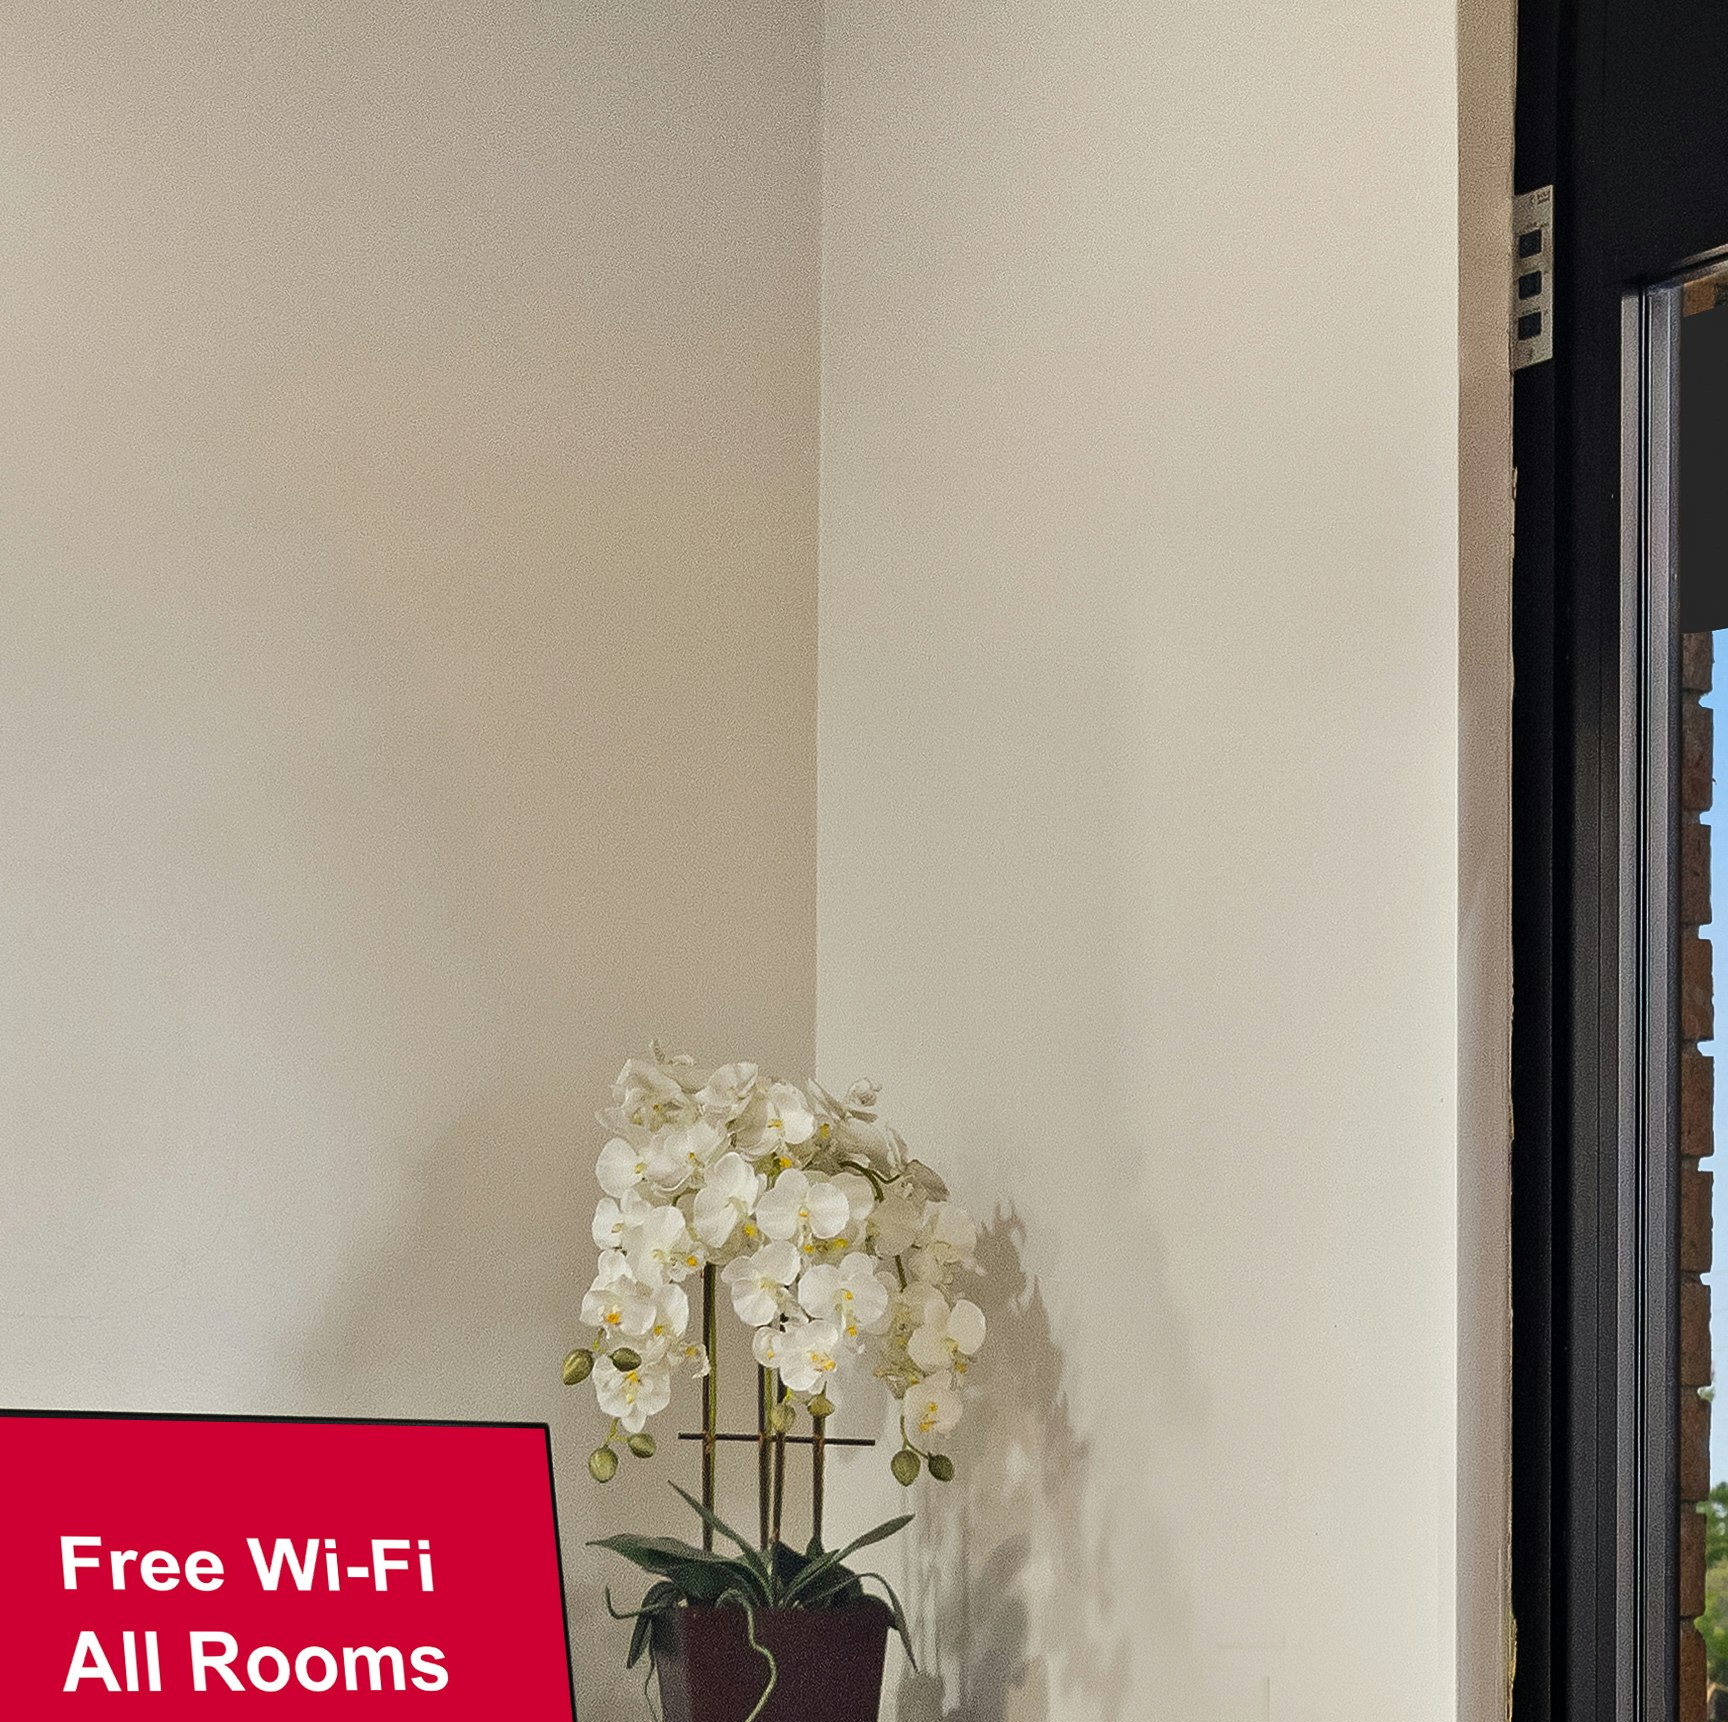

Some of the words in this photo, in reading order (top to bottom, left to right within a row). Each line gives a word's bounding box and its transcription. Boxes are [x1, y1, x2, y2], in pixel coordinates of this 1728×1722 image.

[59, 1535, 225, 1592] Free
[246, 1537, 434, 1592] Wi-Fi
[62, 1630, 162, 1692] All
[189, 1630, 449, 1693] Rooms
